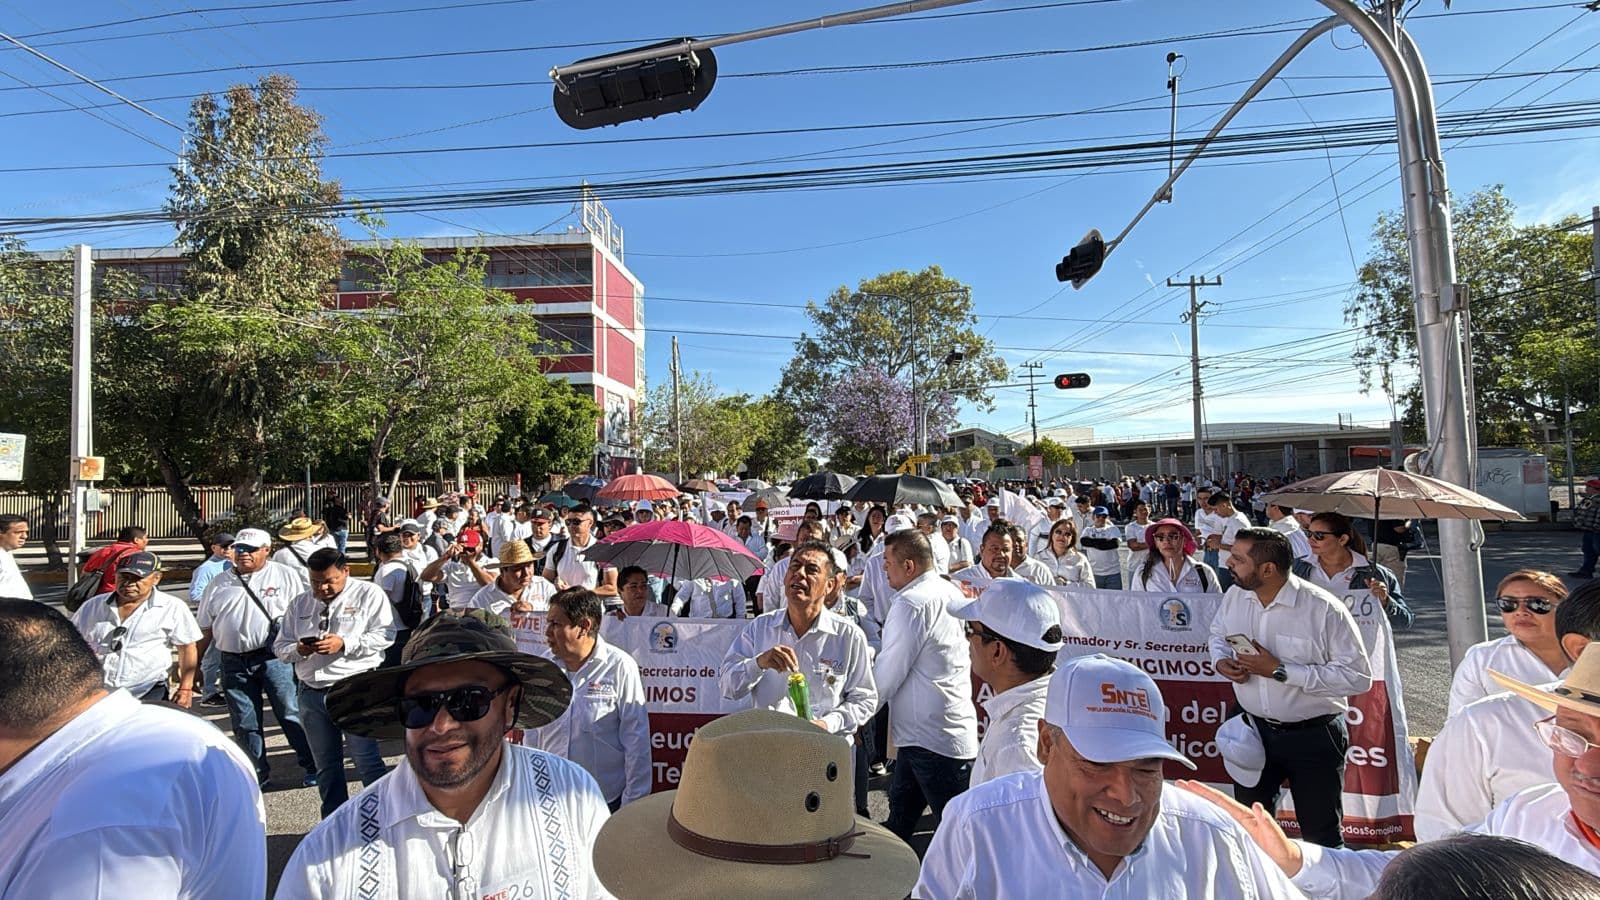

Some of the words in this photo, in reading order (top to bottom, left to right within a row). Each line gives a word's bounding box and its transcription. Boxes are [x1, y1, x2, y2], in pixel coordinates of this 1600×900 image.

[1062, 636, 1112, 648] ernador
[1113, 640, 1123, 650] y
[1124, 639, 1142, 650] Sr.
[699, 666, 716, 678] de
[646, 687, 697, 703] IMOS
[1101, 683, 1148, 708] SNTE
[1181, 700, 1227, 724] del
[1343, 706, 1364, 726] o
[1344, 746, 1388, 768] es
